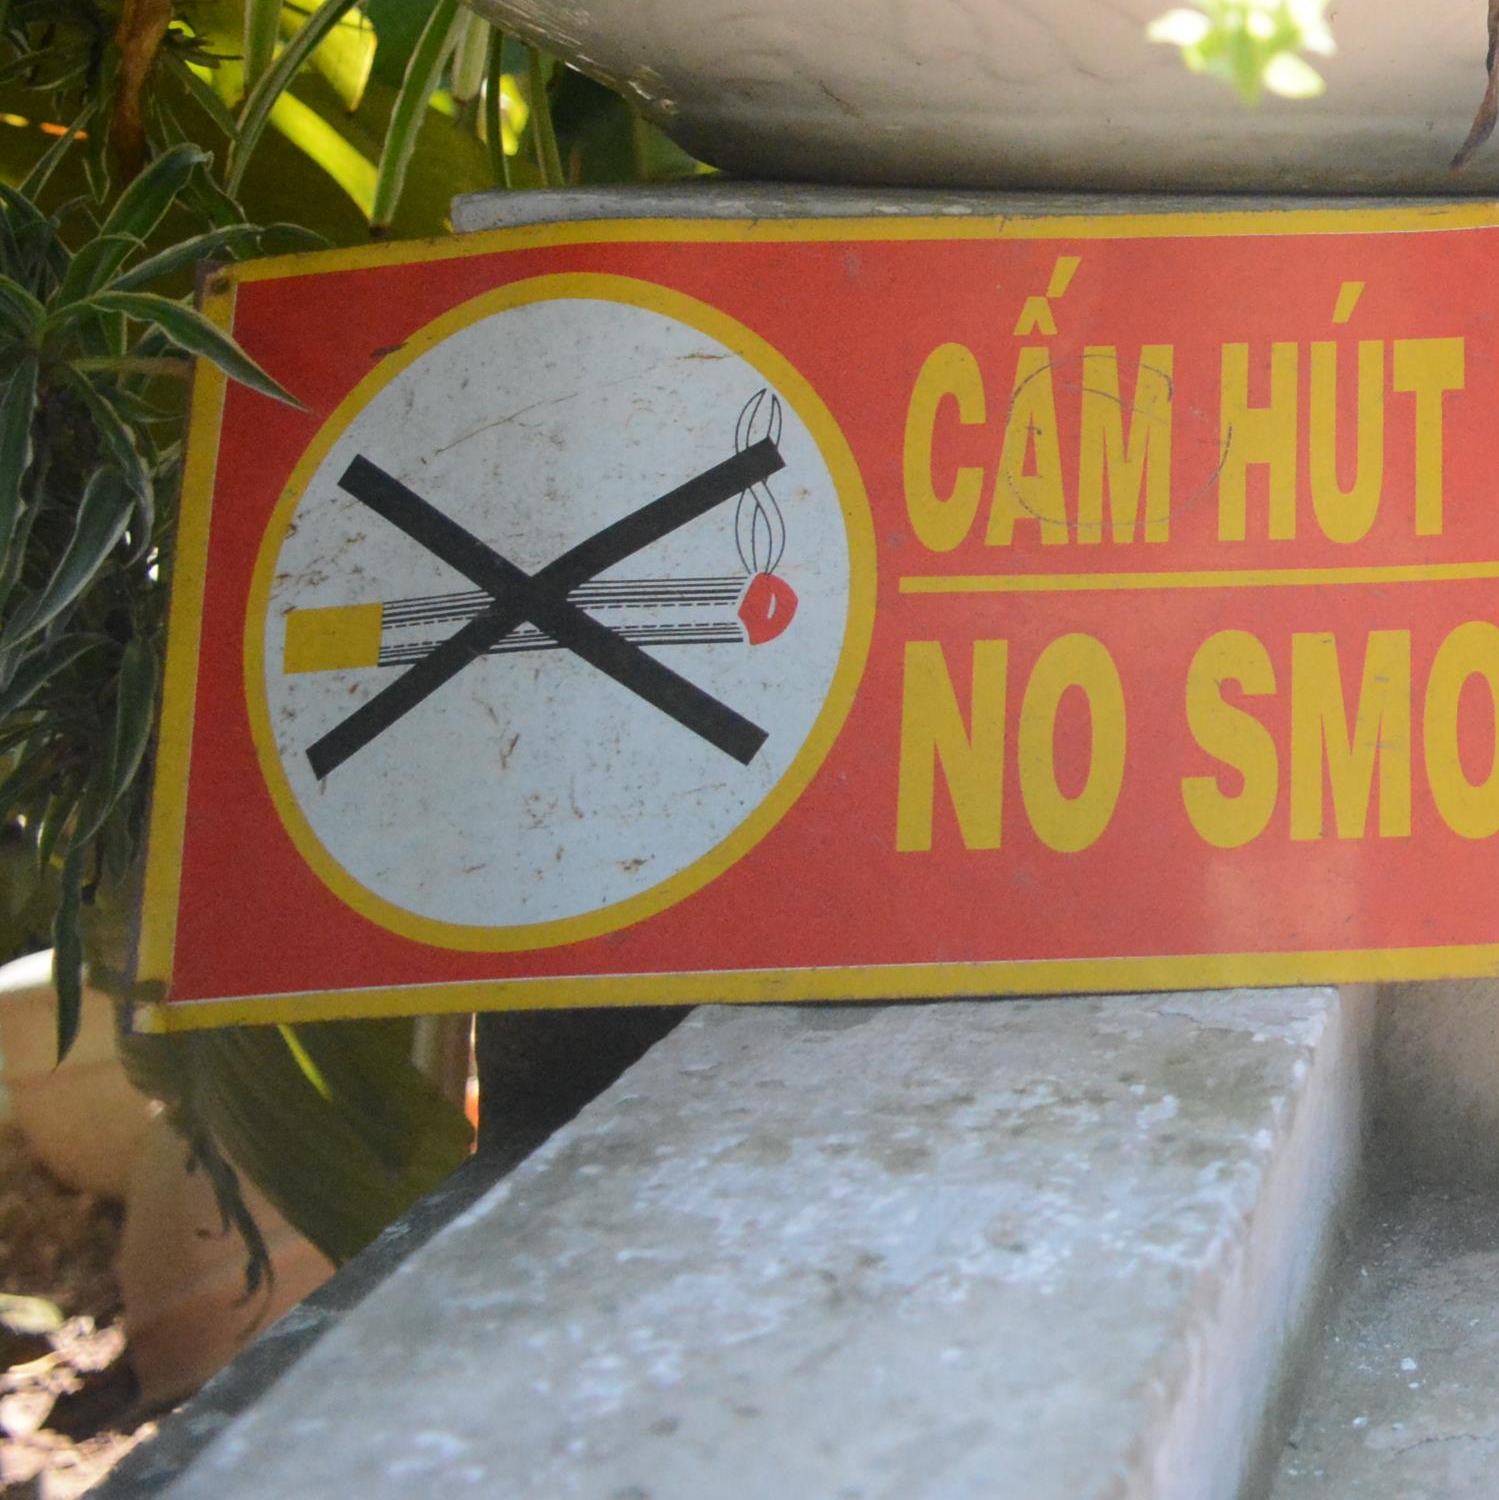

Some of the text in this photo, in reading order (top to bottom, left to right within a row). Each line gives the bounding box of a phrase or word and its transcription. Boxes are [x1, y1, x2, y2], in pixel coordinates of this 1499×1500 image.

[903, 256, 1173, 552] CẤM
[1218, 283, 1464, 544] HÚT
[895, 633, 1127, 853] NO
